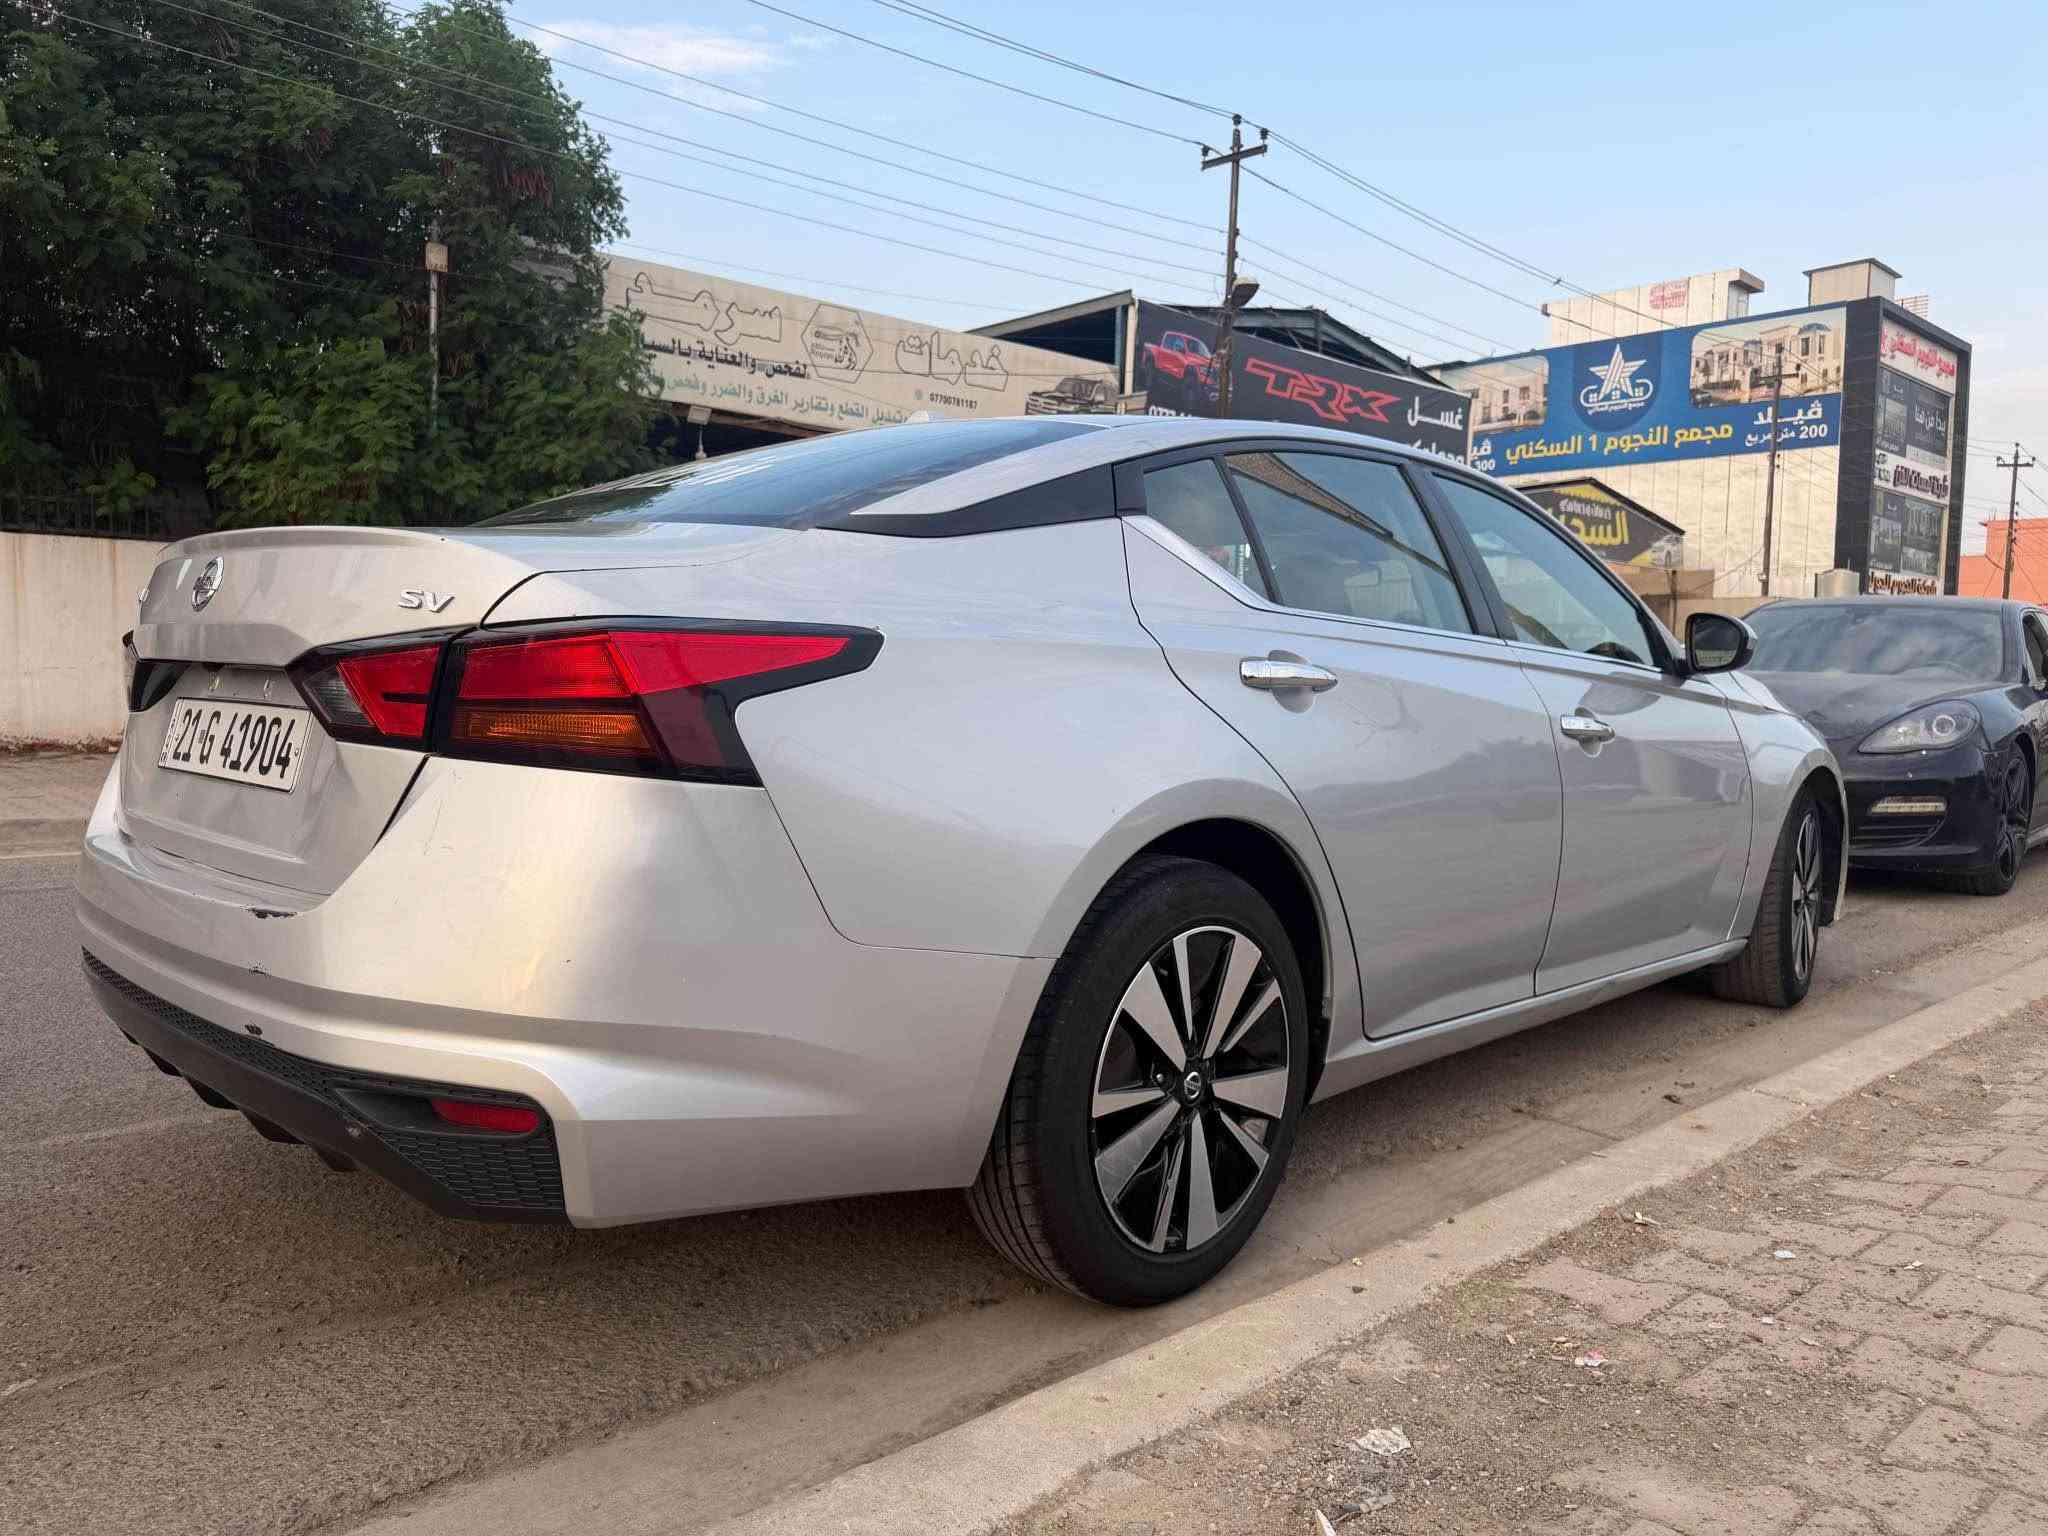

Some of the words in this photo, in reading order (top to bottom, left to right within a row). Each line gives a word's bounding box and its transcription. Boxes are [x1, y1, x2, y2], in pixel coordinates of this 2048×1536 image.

[1246, 358, 1401, 423] TRX
[1407, 396, 1463, 430] غسل
[1589, 435, 1597, 452] 1
[1603, 425, 1669, 455] النجوم
[1674, 422, 1734, 443] مجمع
[1799, 423, 1829, 440] 200
[1506, 434, 1583, 465] السكني
[398, 590, 455, 613] SV
[173, 708, 202, 762] 21
[200, 710, 221, 764] G
[220, 712, 296, 778] 41904
